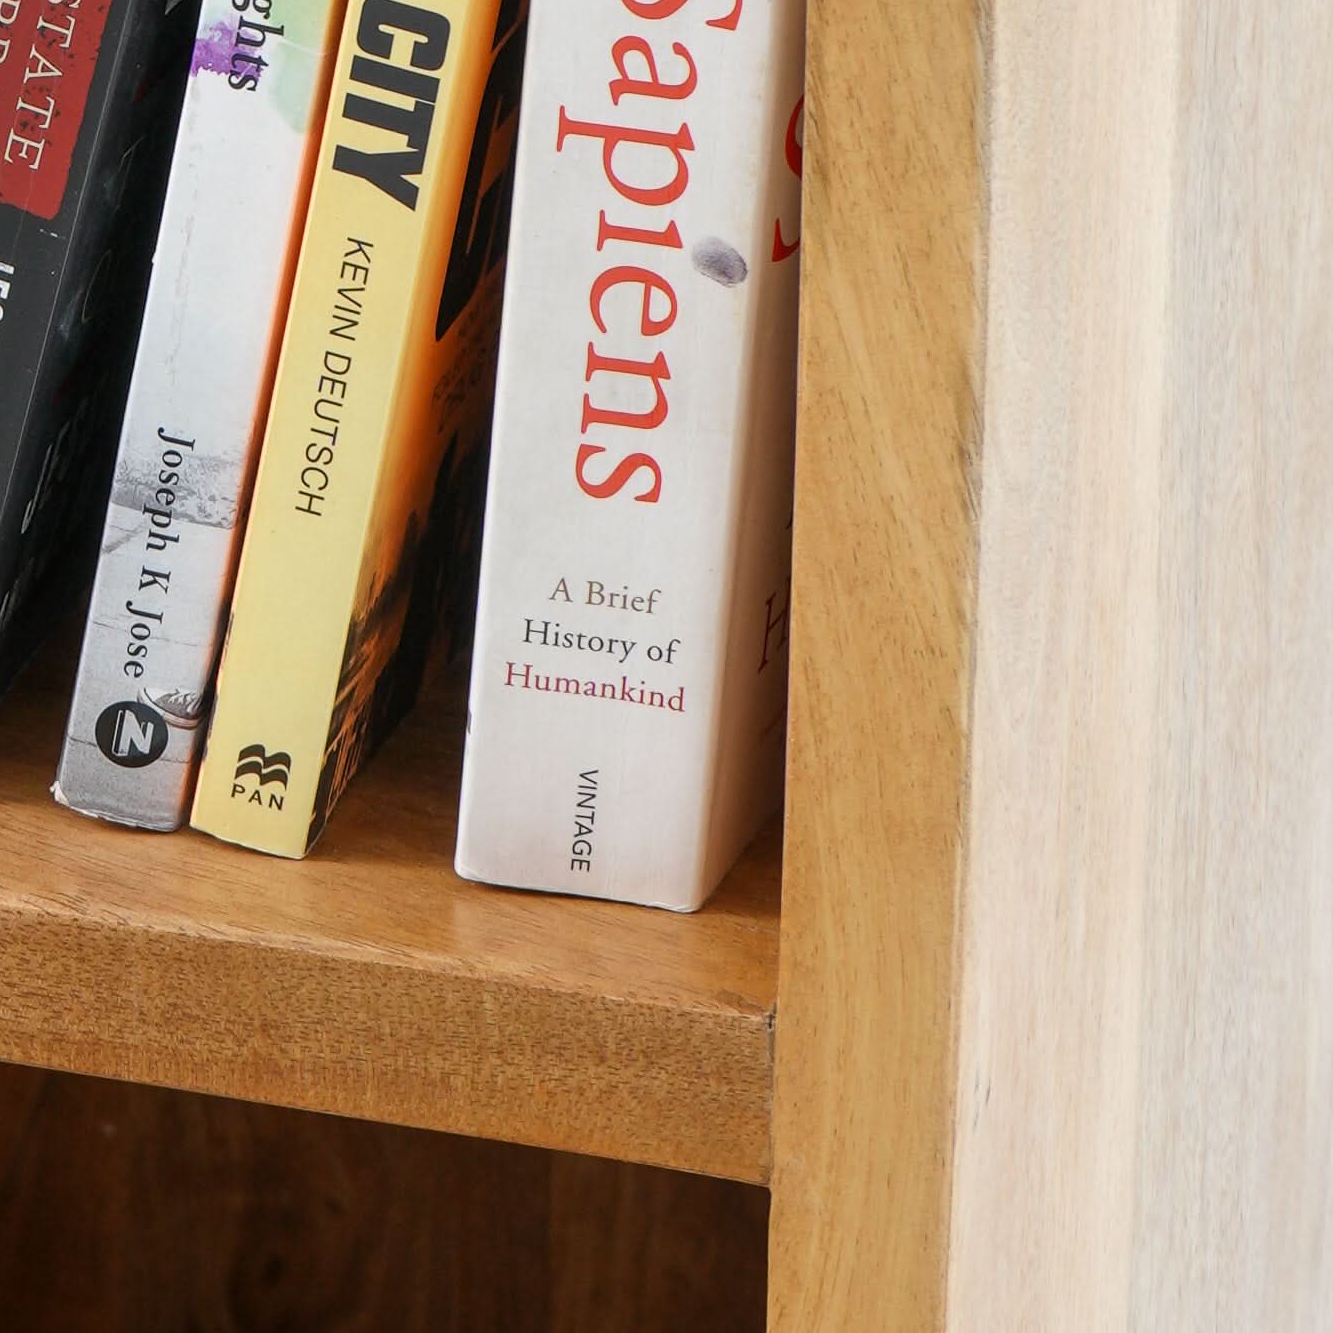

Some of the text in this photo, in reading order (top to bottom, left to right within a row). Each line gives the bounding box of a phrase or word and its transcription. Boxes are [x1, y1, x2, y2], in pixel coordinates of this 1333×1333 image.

[294, 236, 374, 517] KEVIN DEUTSCH
[123, 427, 195, 679] Joseph K Jose
[548, 577, 662, 615] A Brief
[522, 618, 682, 665] History of
[504, 661, 686, 713] Humankind
[231, 782, 284, 811] PAN
[569, 767, 599, 873] VINTAGE
